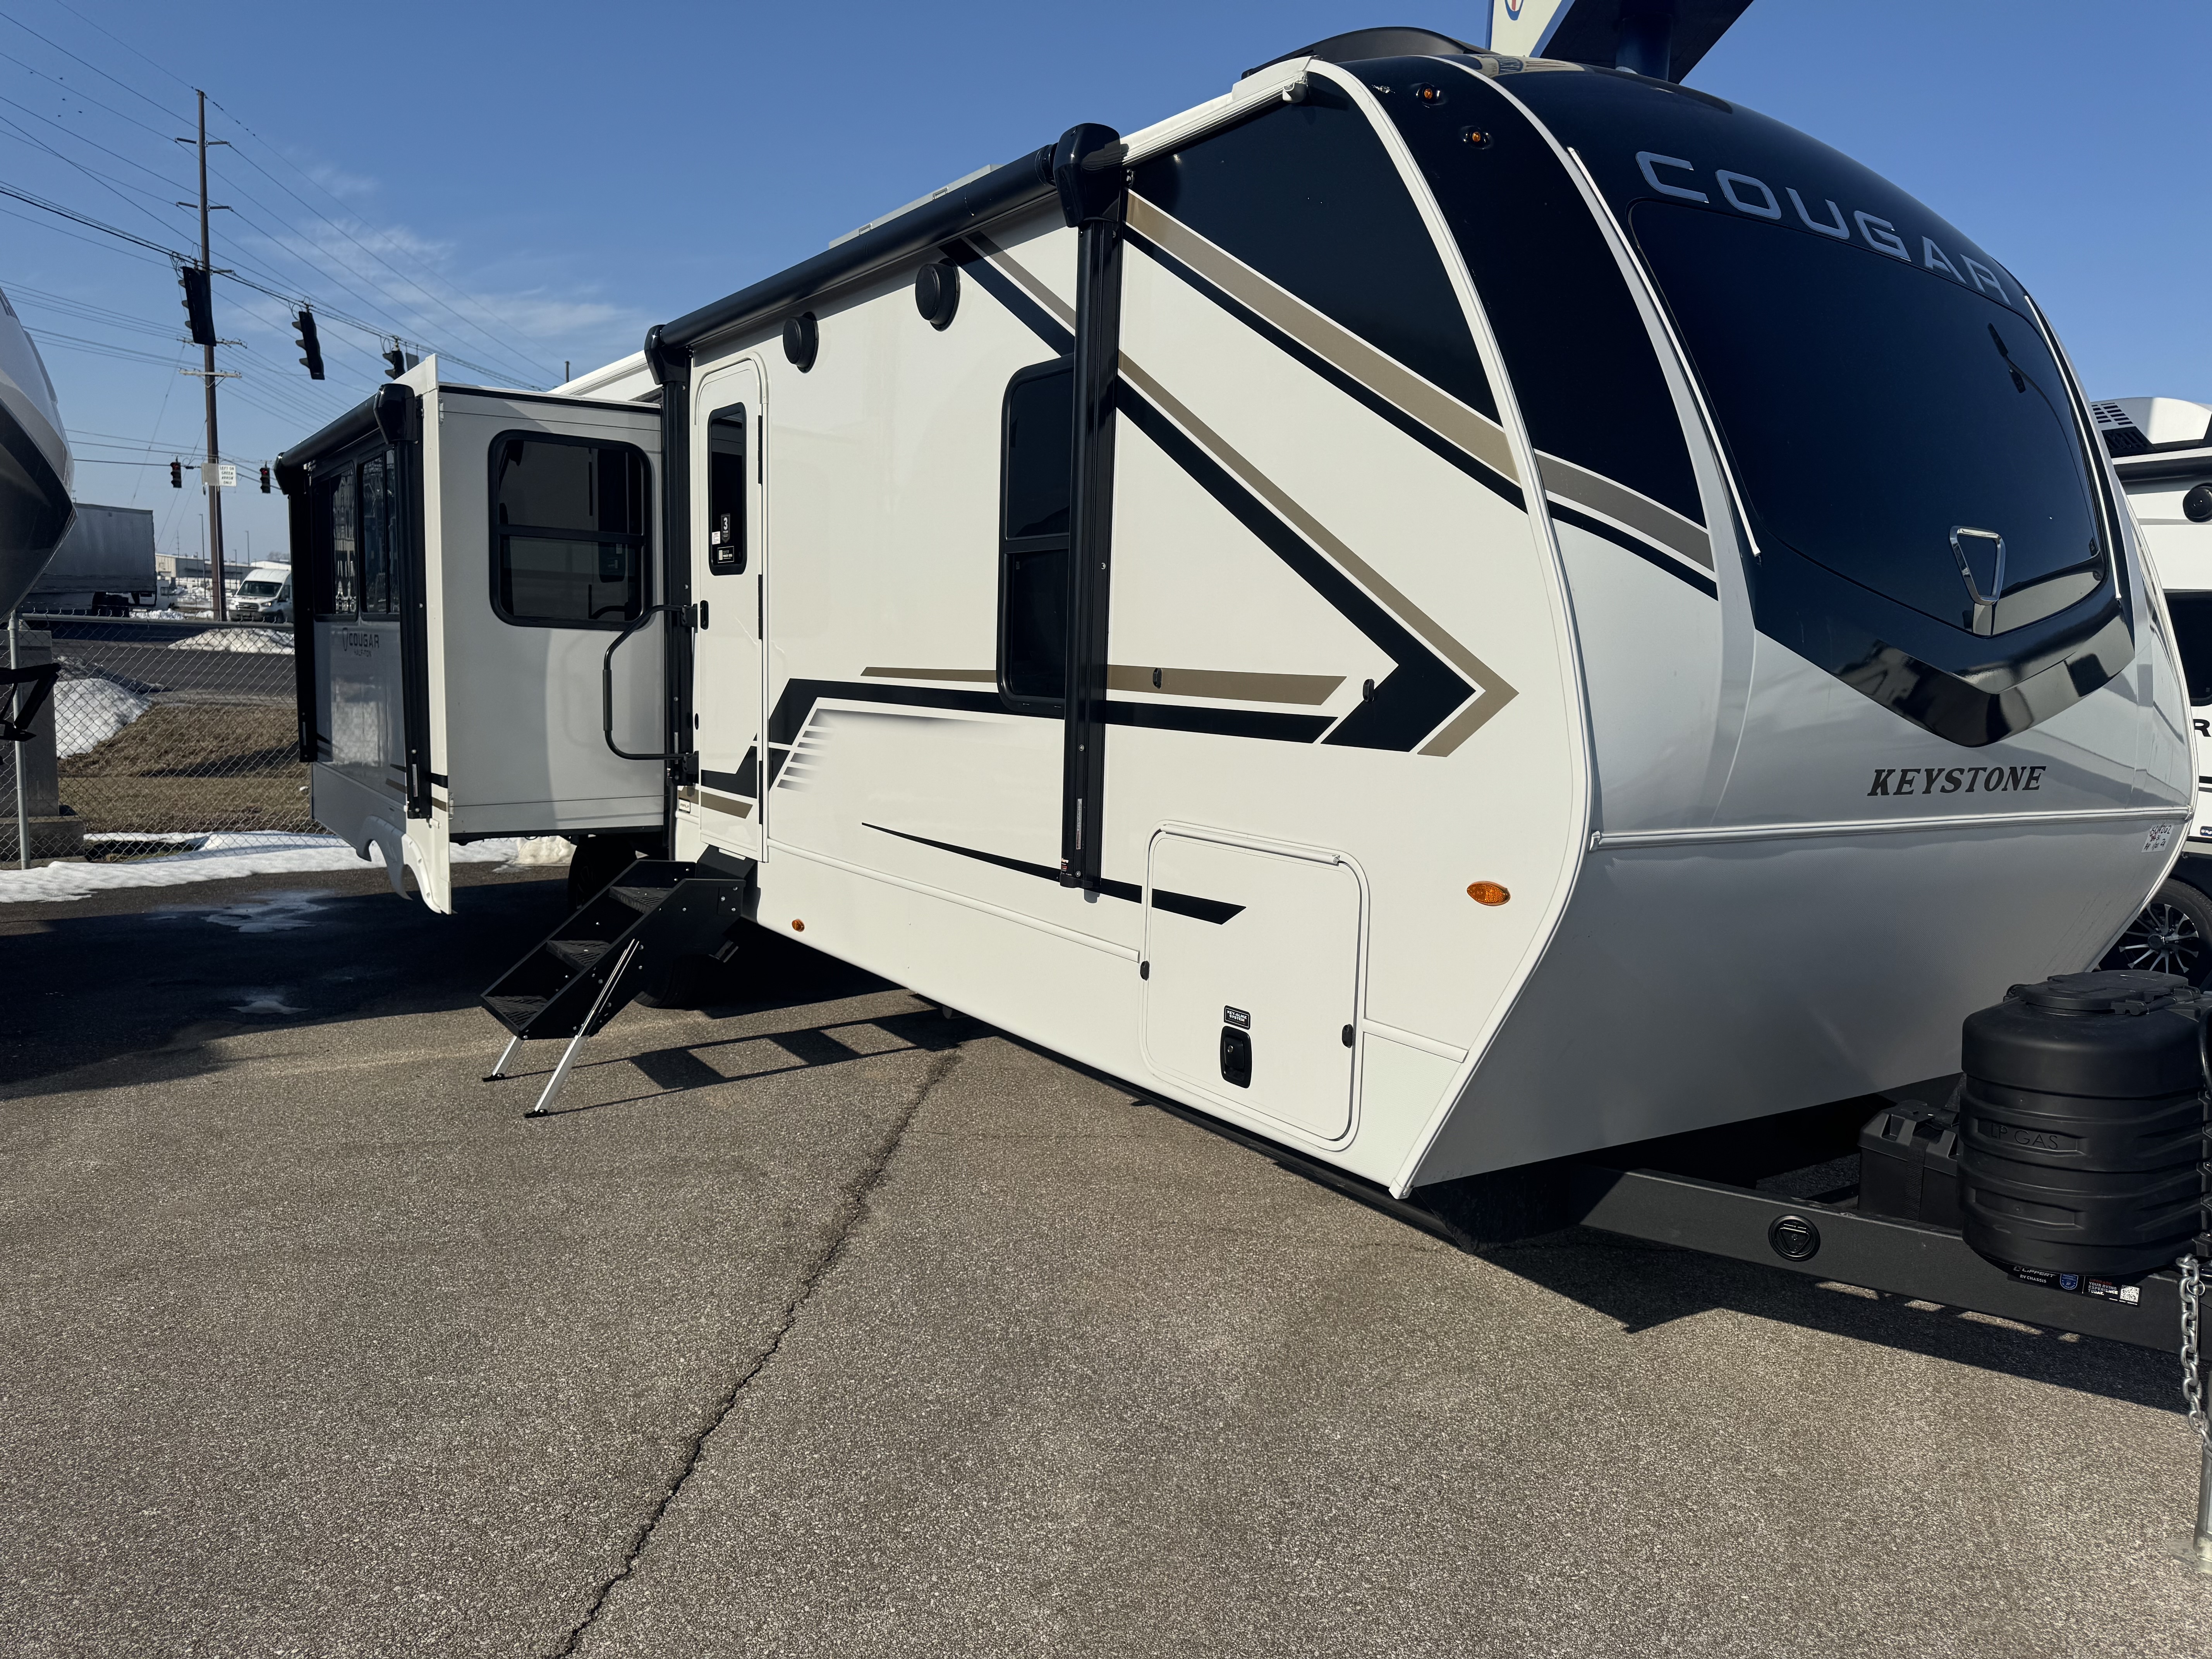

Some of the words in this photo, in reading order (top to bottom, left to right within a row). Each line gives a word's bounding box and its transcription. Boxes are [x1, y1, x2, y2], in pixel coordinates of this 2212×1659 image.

[1635, 150, 2012, 306] COUGAR
[723, 517, 728, 530] 3
[349, 633, 379, 648] COUGAR
[1867, 766, 2046, 796] KEYSTONE
[1227, 1010, 1247, 1019] KEY-ALIKE
[1991, 1123, 2008, 1140] LP
[2014, 1130, 2058, 1150] GAS
[2022, 1268, 2057, 1278] LIPPERT
[2088, 1285, 2118, 1295] EXPERIENCE
